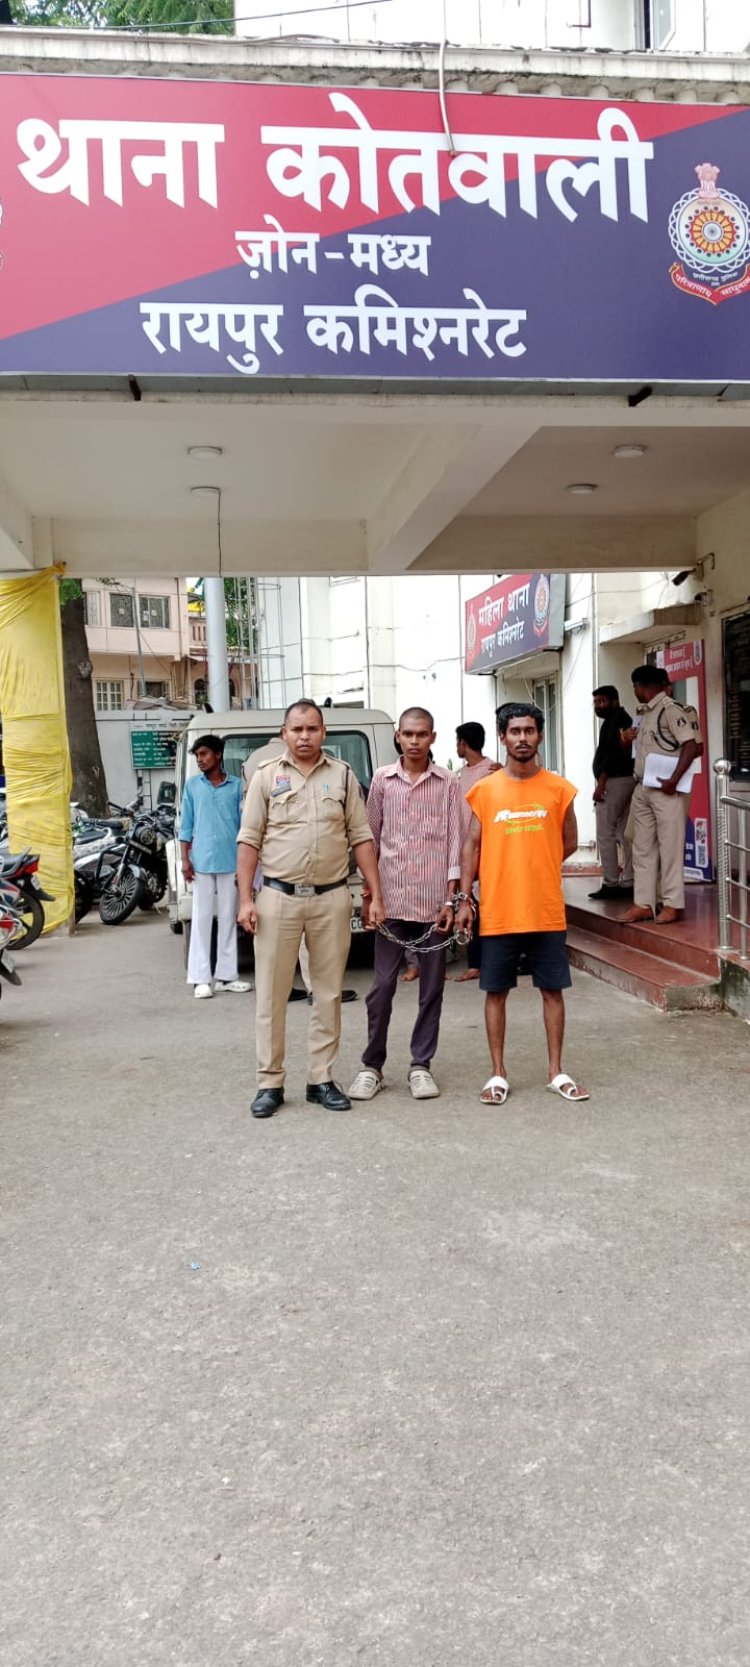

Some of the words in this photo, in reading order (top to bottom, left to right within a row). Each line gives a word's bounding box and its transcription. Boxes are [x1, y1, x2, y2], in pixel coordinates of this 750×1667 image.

[17, 118, 225, 208] थाना
[261, 92, 653, 223] कोतवाली
[139, 302, 284, 374] रायपुर
[303, 284, 527, 360] कमिश्नरेट
[478, 596, 505, 627] महिला
[507, 582, 530, 612] थाना
